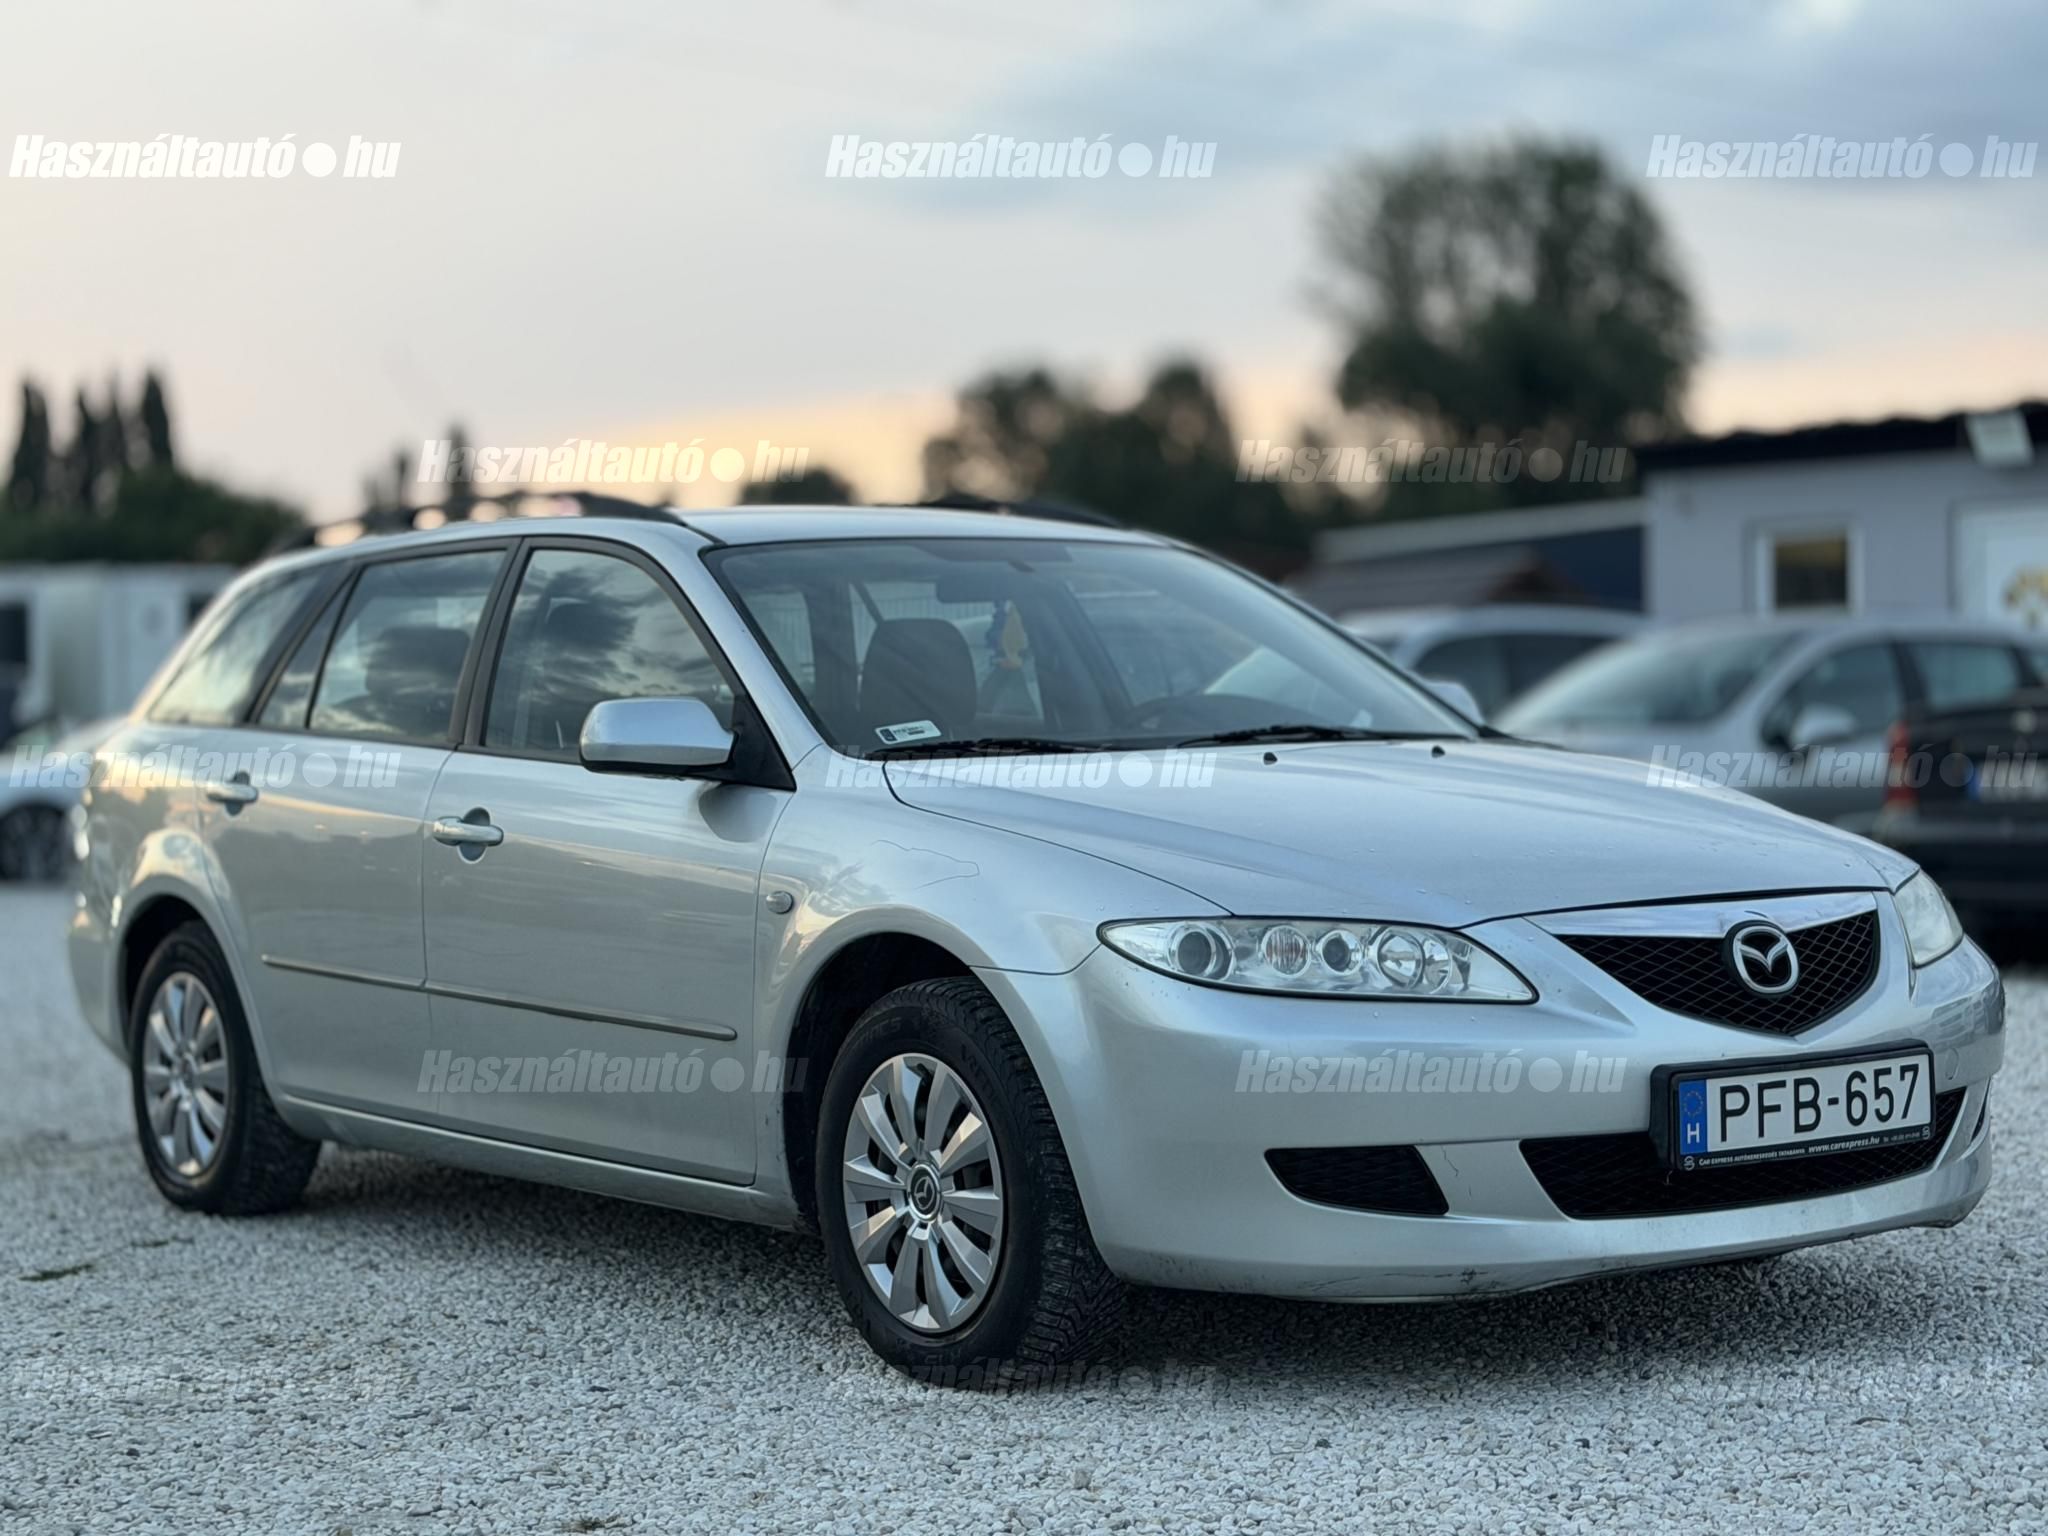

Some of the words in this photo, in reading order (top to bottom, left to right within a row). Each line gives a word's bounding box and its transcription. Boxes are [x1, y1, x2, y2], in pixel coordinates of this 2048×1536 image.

[1719, 1064, 1920, 1142] PFB-657
[1686, 1123, 1701, 1145] H
[1808, 1136, 1880, 1153] www.carexpress.hu
